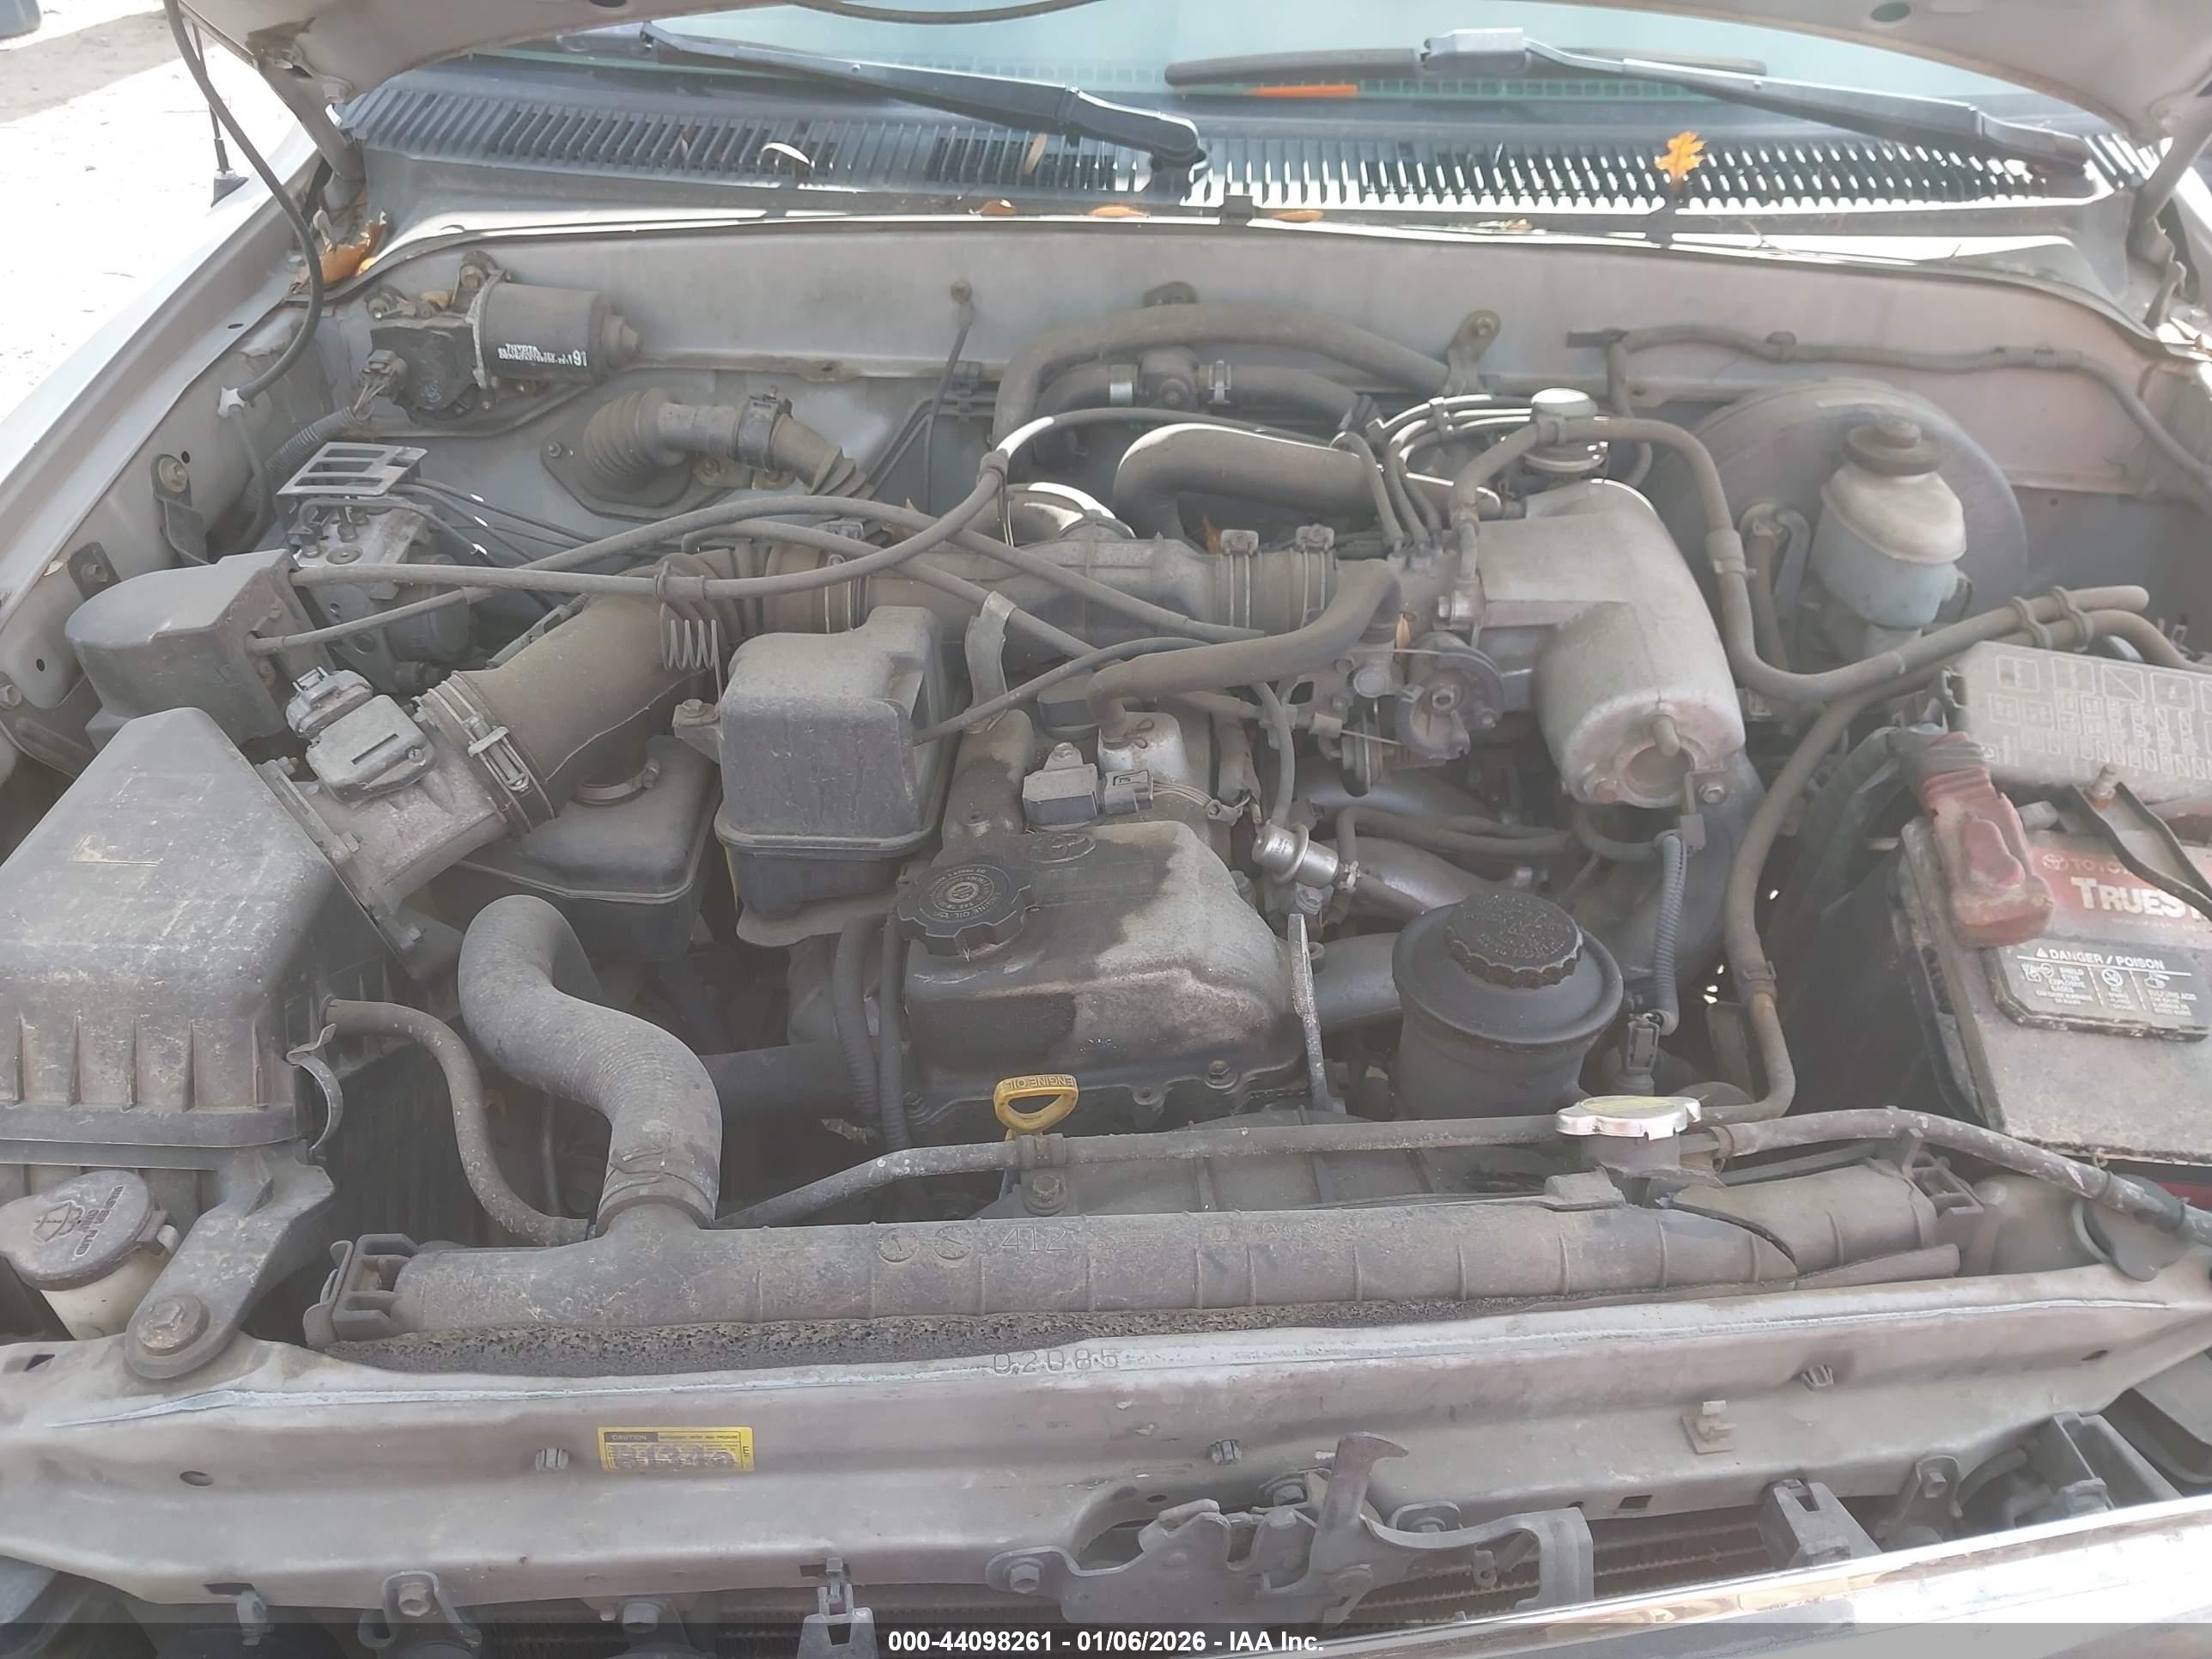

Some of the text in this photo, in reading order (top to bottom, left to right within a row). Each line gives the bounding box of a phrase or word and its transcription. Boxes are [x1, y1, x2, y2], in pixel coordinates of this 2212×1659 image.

[2068, 857, 2130, 874] TOYO
[2048, 948, 2104, 964] DANGER
[2115, 956, 2165, 970] POISON
[1004, 1076, 1074, 1090] ENGINE OIL
[1000, 1225, 1068, 1253] 412
[994, 1347, 1121, 1374] 02085
